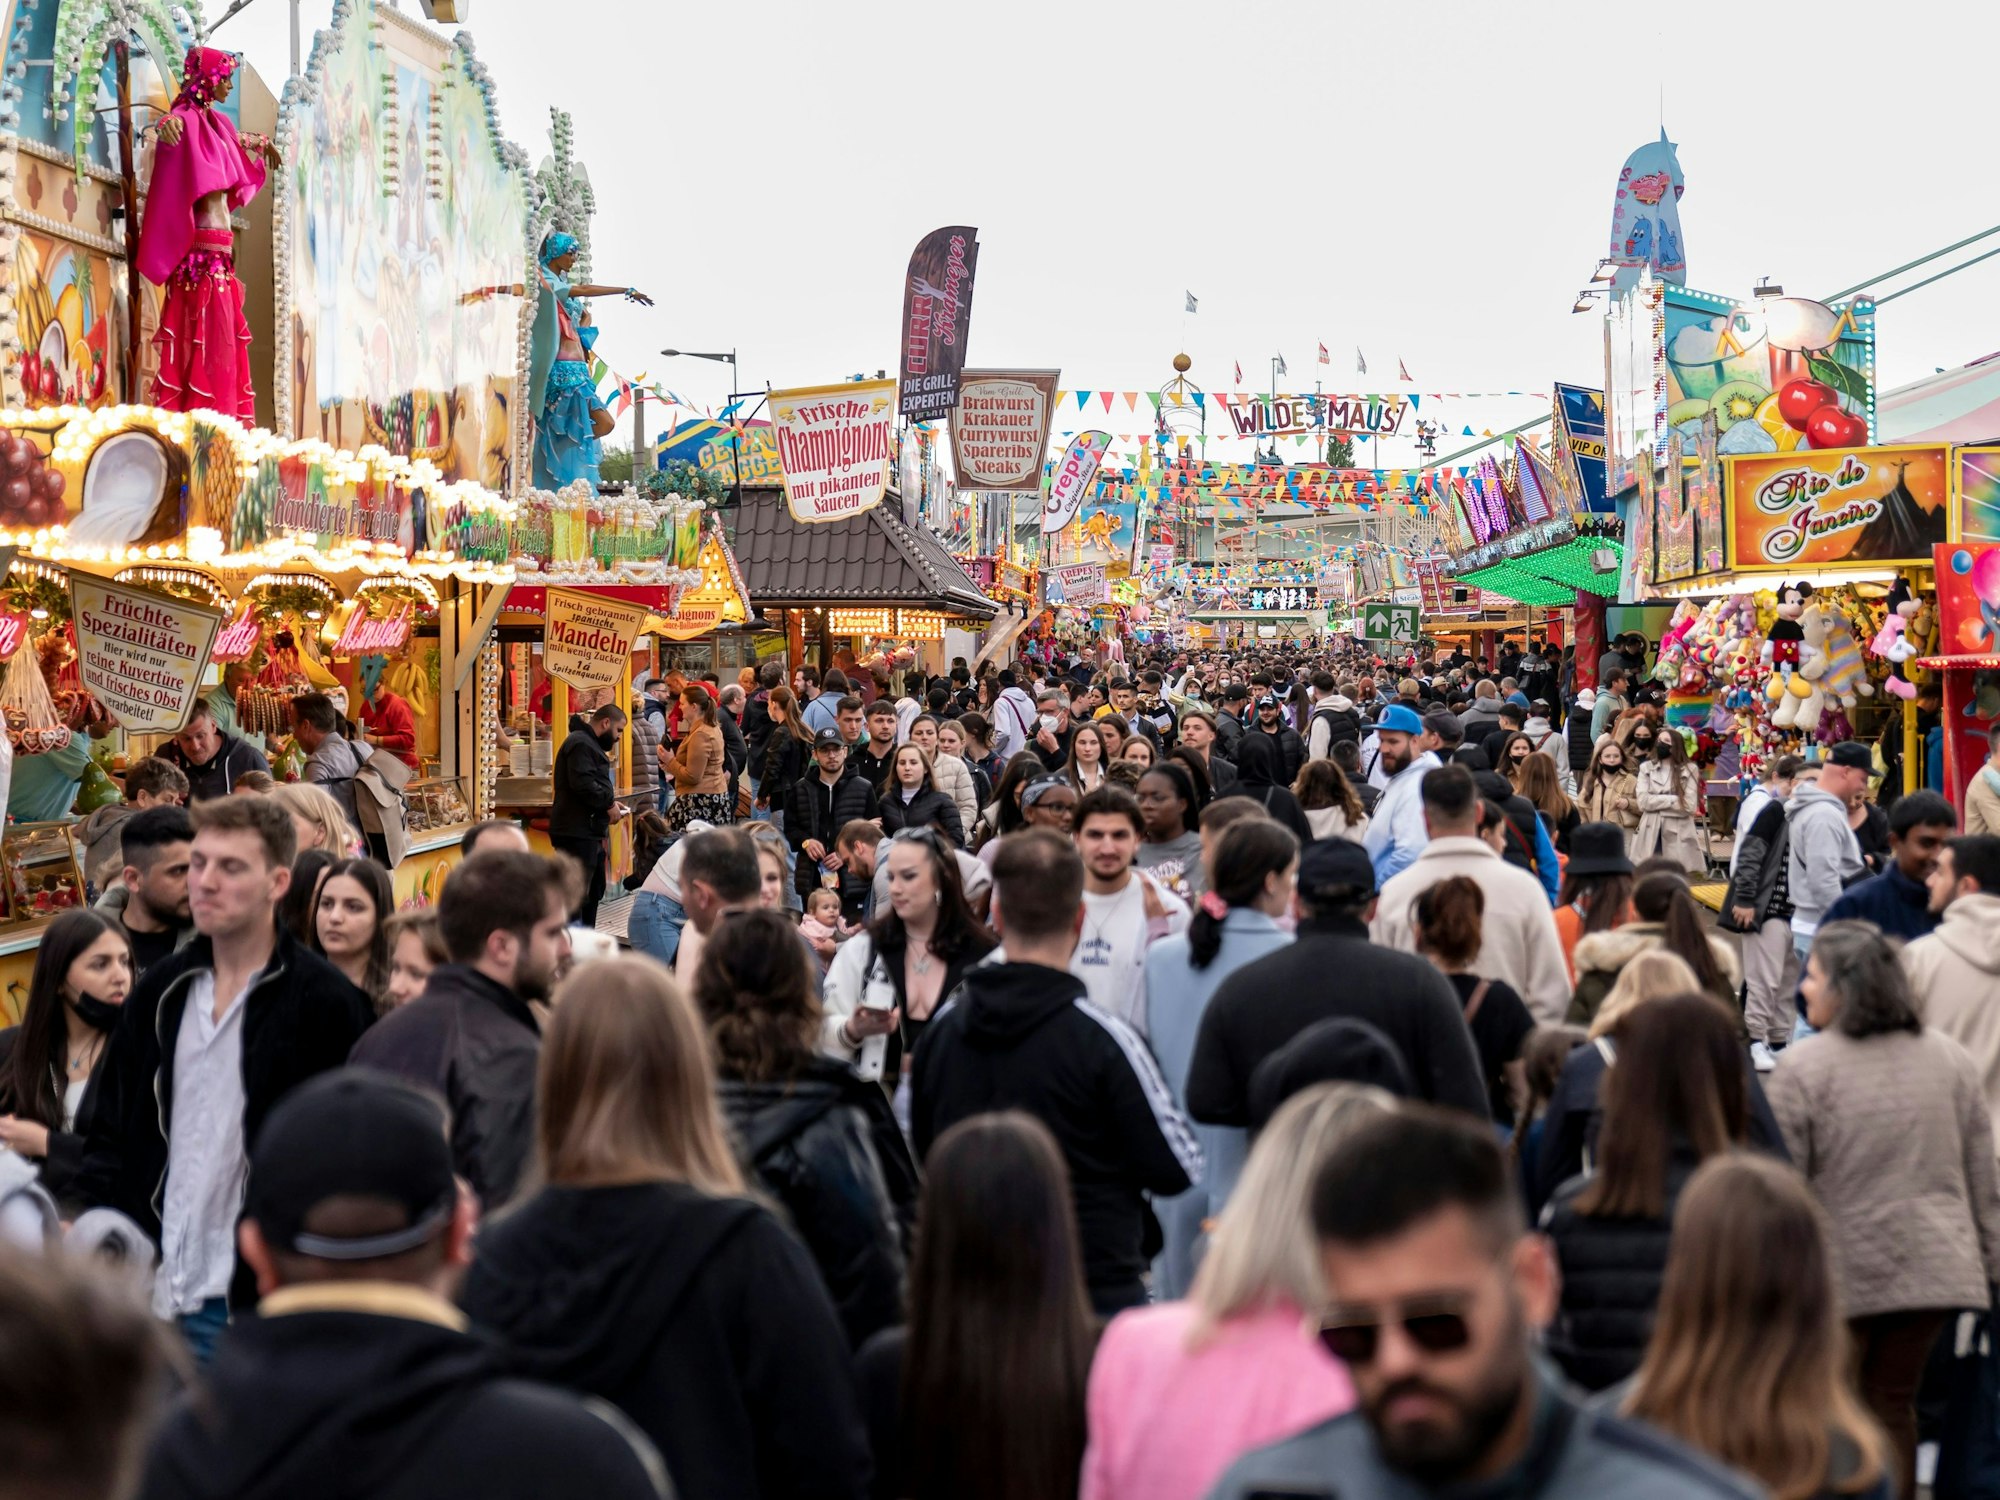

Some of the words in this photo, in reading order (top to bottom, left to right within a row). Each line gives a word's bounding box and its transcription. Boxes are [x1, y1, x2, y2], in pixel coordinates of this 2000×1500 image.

[903, 378, 921, 394] DIE
[923, 374, 956, 391] GRILL-
[797, 400, 869, 425] Frische
[902, 390, 955, 411] EXPERTEN
[963, 396, 1035, 411] Bratwurst
[963, 412, 1034, 427] Krakauer
[1234, 402, 1304, 433] WILDE
[1328, 402, 1397, 432] MAUS
[777, 420, 890, 475] Champignons
[959, 428, 1038, 443] Currywurst
[1572, 439, 1590, 452] VIP
[963, 444, 1032, 459] Spareribs
[974, 460, 1021, 474] Steaks
[792, 481, 816, 500] mit
[819, 471, 880, 497] pikanten
[1065, 478, 1084, 513] Original
[1760, 471, 1830, 511] Rio
[1837, 458, 1865, 487] de
[273, 486, 346, 536] Kandierte
[348, 497, 399, 540] Früchte
[813, 493, 860, 514] Saucen
[1766, 502, 1878, 560] Janeiro
[1060, 565, 1093, 578] CREPES
[1066, 591, 1095, 602] nutella
[104, 594, 180, 629] Früchte-
[554, 598, 582, 611] Frisch
[585, 605, 636, 623] gebrannte
[571, 613, 615, 629] spanische
[846, 617, 881, 627] Bratwurst
[82, 611, 197, 658] Spezialitäten
[550, 621, 628, 656] Mandeln
[914, 623, 932, 632] Ribs
[104, 642, 122, 656] Hier
[126, 650, 147, 663] wird
[149, 656, 167, 668] nur
[549, 642, 564, 653] mit
[566, 647, 592, 660] wenig
[593, 651, 623, 665] Zucker
[86, 651, 115, 671] reine
[119, 660, 184, 690] Kuvertüre
[552, 663, 613, 683] Spitzenqualität
[85, 667, 103, 686] und
[106, 674, 150, 703] frisches
[153, 690, 182, 710] Obst
[104, 695, 154, 721] verarbeitet!
